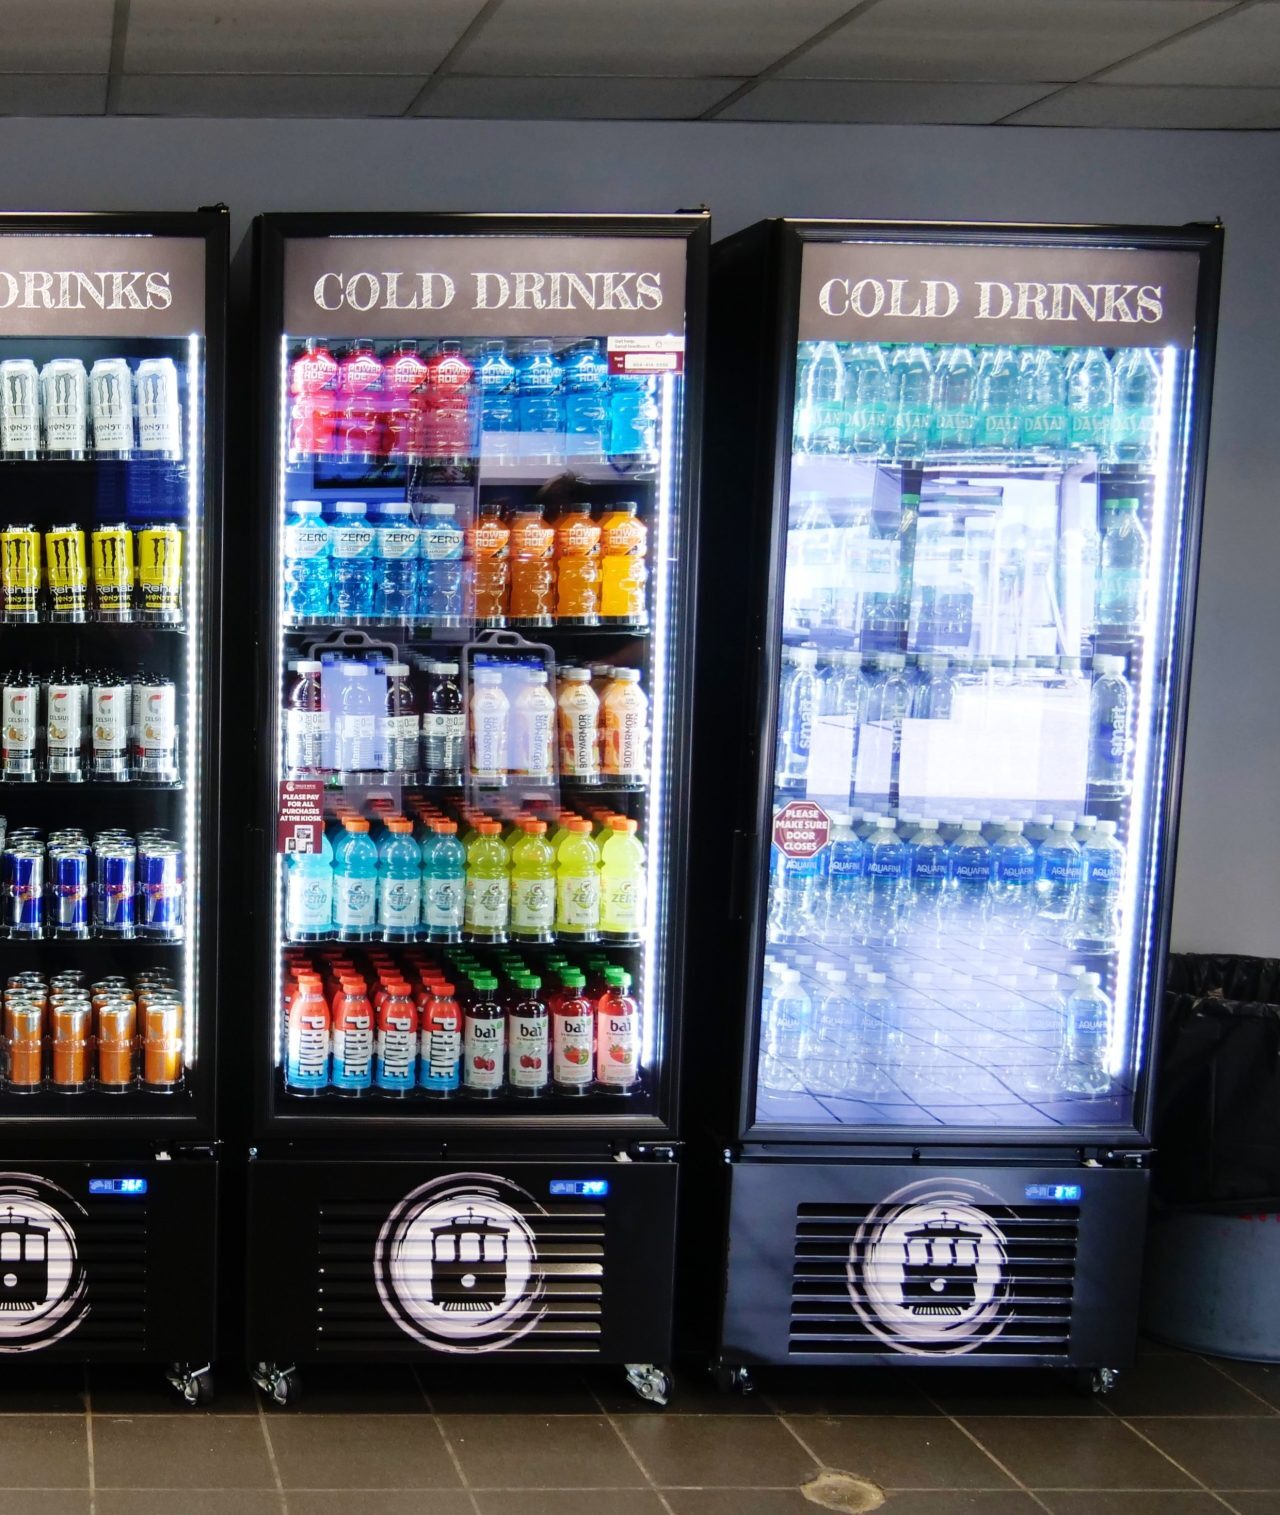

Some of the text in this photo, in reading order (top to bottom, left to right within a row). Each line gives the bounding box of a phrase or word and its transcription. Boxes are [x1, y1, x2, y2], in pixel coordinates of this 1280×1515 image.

[314, 272, 664, 311] COLD DRINKS
[818, 278, 1164, 323] COLD DRINKS
[304, 362, 336, 372] POWER
[348, 362, 380, 372] POWER
[396, 366, 428, 374] POWER
[438, 366, 470, 374] POWER
[482, 367, 514, 376] POWER
[580, 366, 608, 374] POWE
[304, 372, 324, 380] ADE
[348, 372, 367, 381] ADE
[533, 368, 564, 377] POWER
[394, 374, 415, 383] ADE
[438, 375, 458, 383] ADE
[482, 376, 502, 384] ADE
[532, 377, 552, 385] ADE
[580, 374, 600, 382] ADE
[1024, 414, 1066, 432] DASAN
[299, 532, 328, 542] ZERO
[340, 533, 370, 542] ZERO
[476, 530, 510, 539] POWER
[525, 530, 554, 539] POWER
[569, 528, 602, 537] POWER
[385, 533, 416, 543] ZERO
[430, 534, 460, 544] ZERO
[524, 538, 545, 547] ADE
[476, 539, 497, 548] ADE
[2, 586, 38, 596] Rehab
[50, 584, 86, 595] Rehab
[96, 584, 134, 594] Rehab
[1110, 706, 1126, 756] smart
[482, 716, 492, 770] BODYARMOR
[533, 714, 544, 770] BODYARMOR
[580, 714, 588, 769] BODYARMOR
[624, 712, 634, 768] BODYARMOR
[786, 809, 818, 818] PLEASE
[776, 820, 828, 830] MAKE SURE
[786, 831, 814, 840] DOOR
[784, 842, 816, 852] CLOSES
[829, 861, 860, 872] AQUAFIN
[956, 866, 990, 877] AQUAFIN
[474, 1024, 497, 1038] bai
[520, 1022, 544, 1038] bai
[564, 1019, 588, 1034] bai
[610, 1019, 632, 1033] bai
[298, 1016, 325, 1076] PRIME
[344, 1016, 370, 1077] PRIME
[383, 1016, 412, 1078] PRIME
[428, 1016, 457, 1078] PRIME
